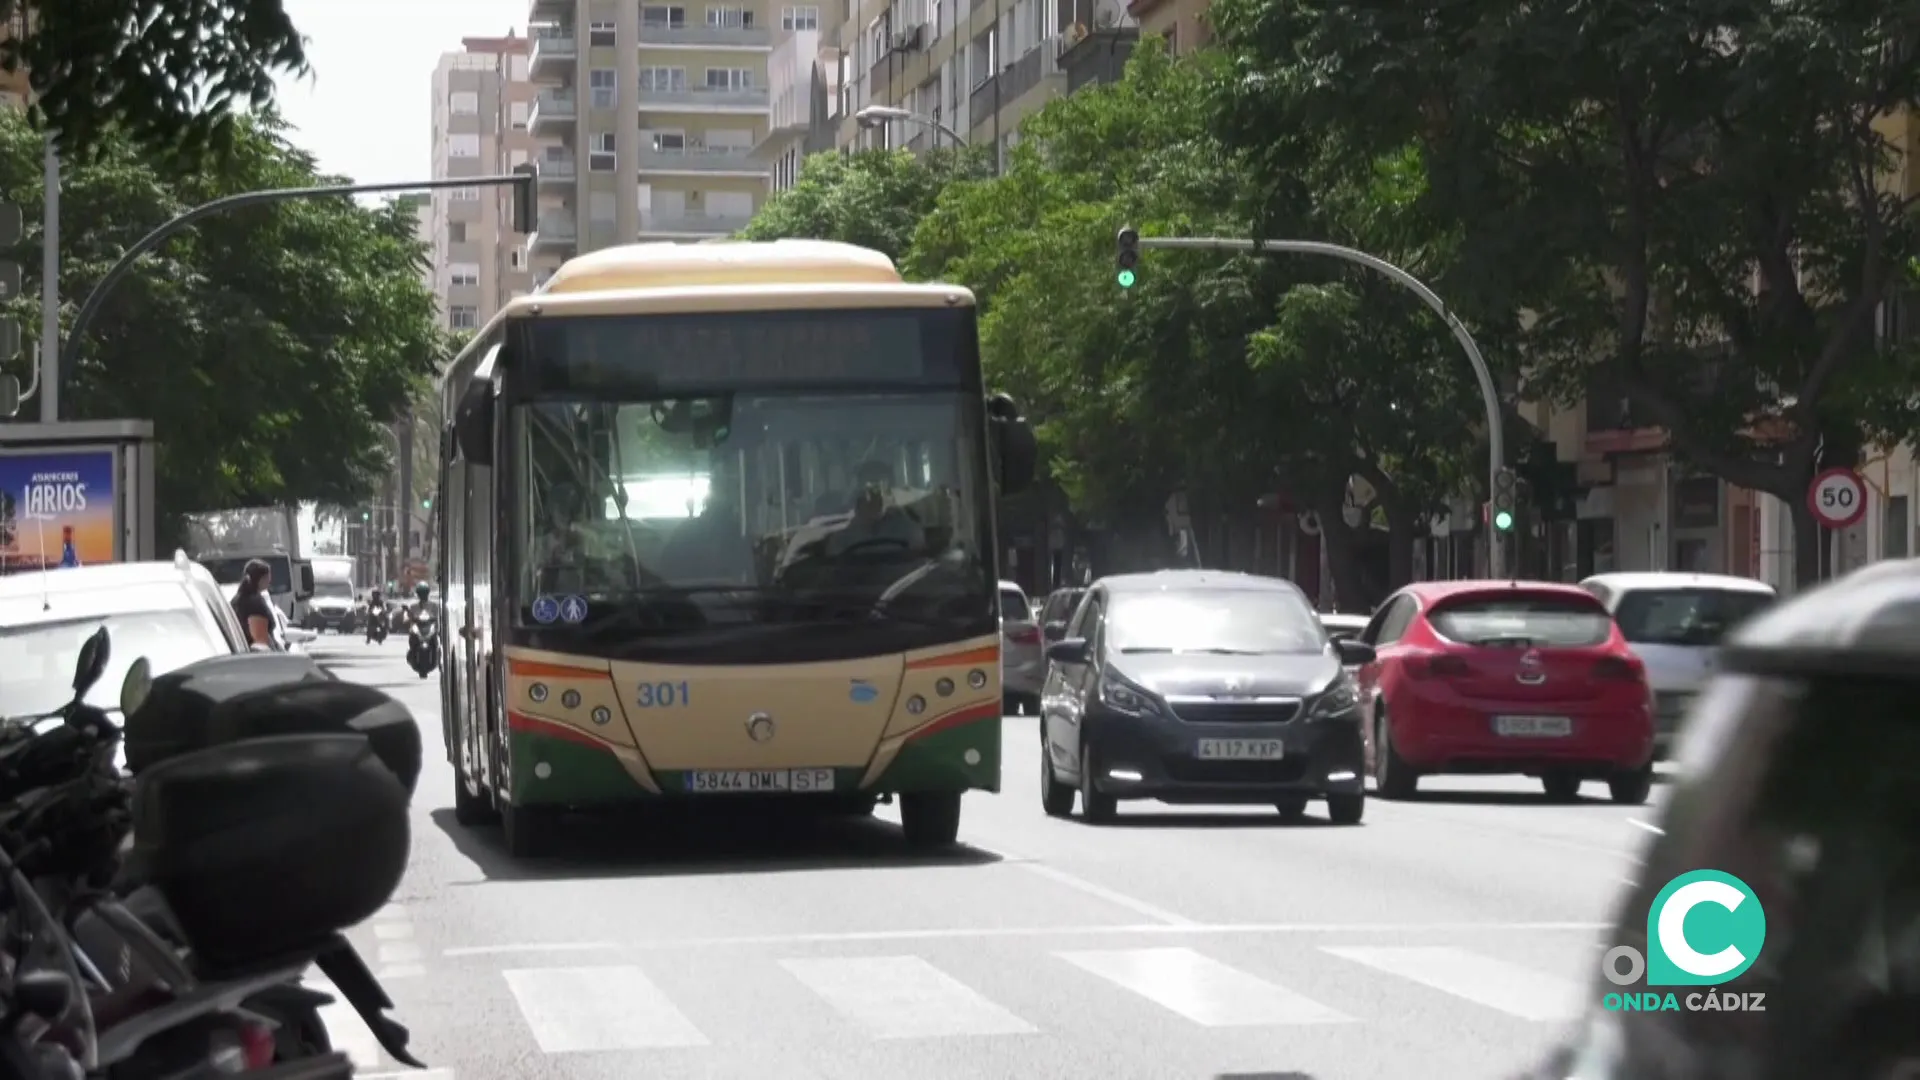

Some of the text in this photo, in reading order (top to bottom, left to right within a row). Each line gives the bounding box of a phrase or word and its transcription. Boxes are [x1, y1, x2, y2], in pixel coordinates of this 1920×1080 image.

[24, 483, 87, 520] LARIOS
[1823, 487, 1853, 508] 50
[637, 682, 690, 707] 301
[696, 770, 742, 789] 5844
[796, 769, 829, 789] SP
